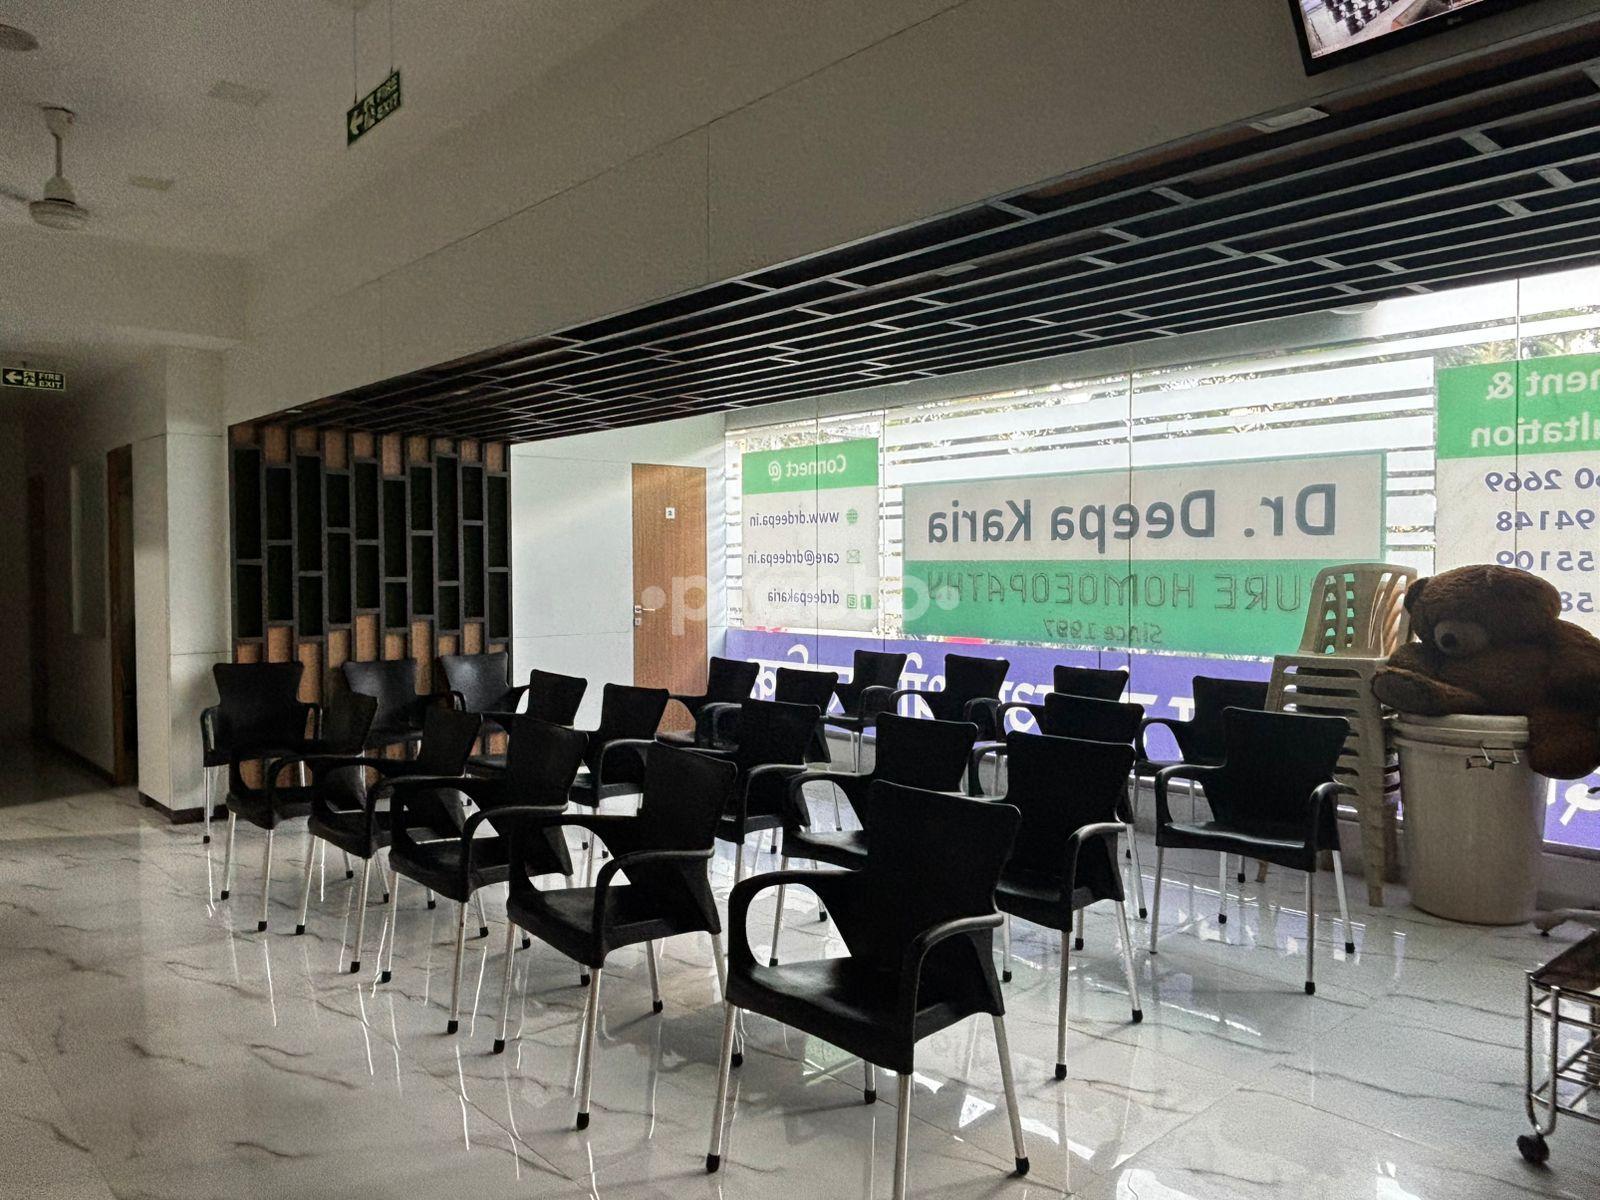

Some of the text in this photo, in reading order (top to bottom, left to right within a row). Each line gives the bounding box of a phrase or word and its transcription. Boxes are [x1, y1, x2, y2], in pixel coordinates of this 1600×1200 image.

[376, 91, 399, 120] EXIT
[39, 372, 61, 380] FIRE
[39, 380, 62, 388] EXIT
